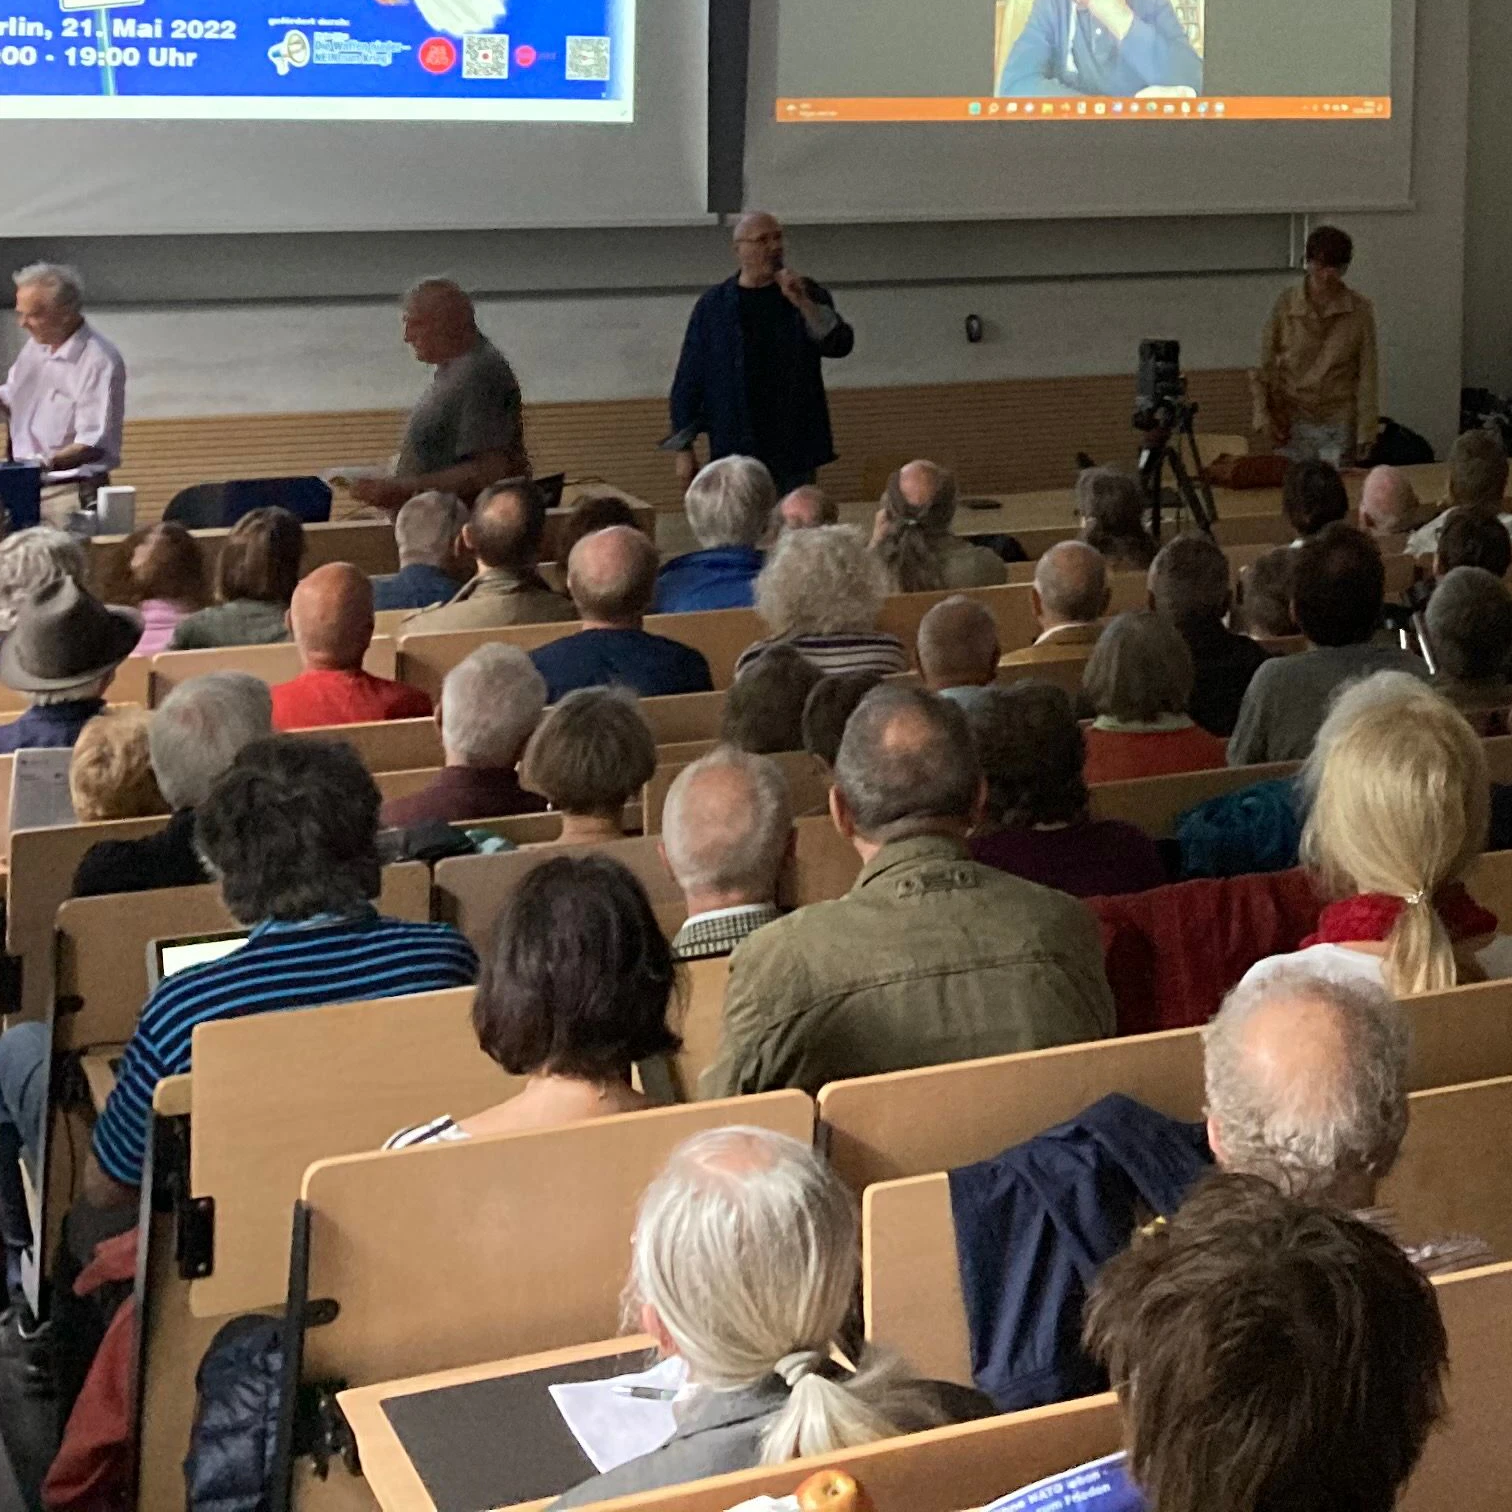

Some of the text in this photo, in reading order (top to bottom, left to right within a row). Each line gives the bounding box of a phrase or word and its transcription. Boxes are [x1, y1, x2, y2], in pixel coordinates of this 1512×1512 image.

[61, 18, 105, 37] 21.
[113, 18, 163, 38] Mai
[170, 20, 237, 39] 2022
[64, 46, 140, 67] 19:00
[148, 47, 198, 67] Uhr
[1028, 1483, 1063, 1504] NATO
